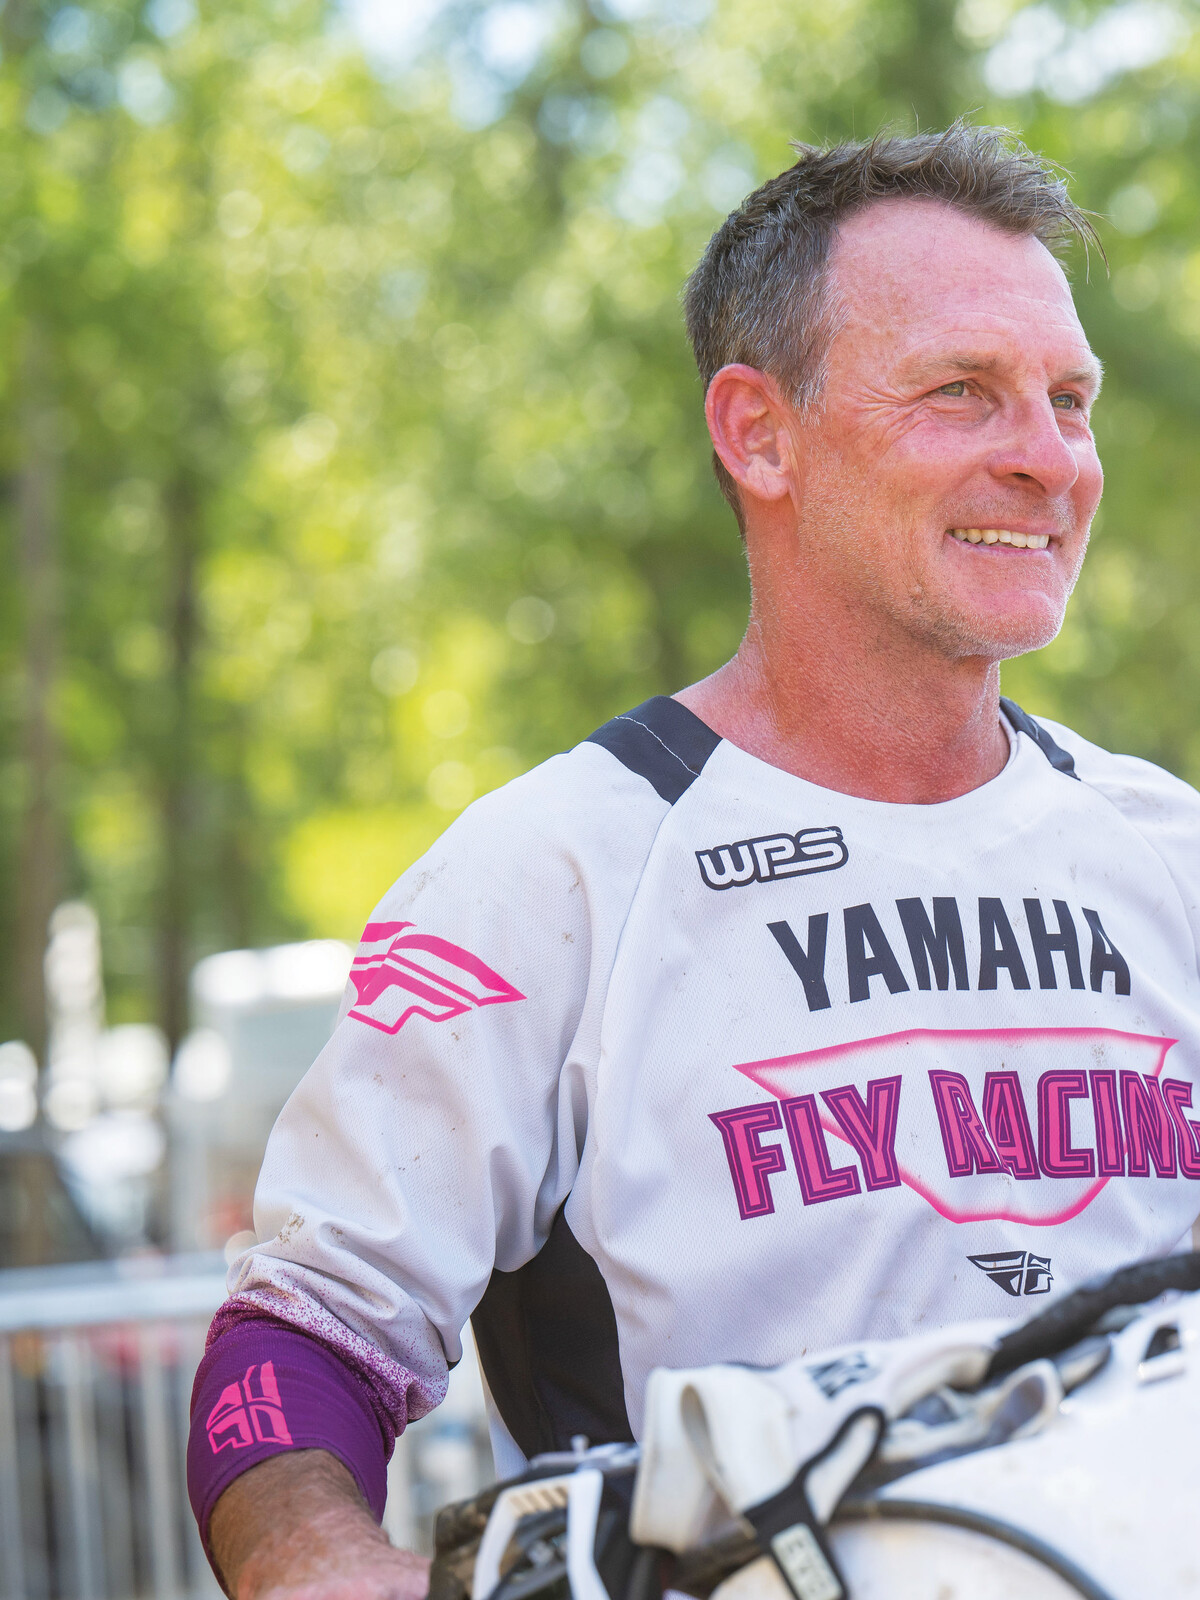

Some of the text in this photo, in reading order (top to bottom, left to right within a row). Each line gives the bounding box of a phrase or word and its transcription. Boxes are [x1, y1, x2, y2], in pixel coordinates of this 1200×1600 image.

[696, 825, 849, 890] WPS
[766, 896, 1132, 1012] YAMAHA
[707, 1074, 902, 1220] FLY
